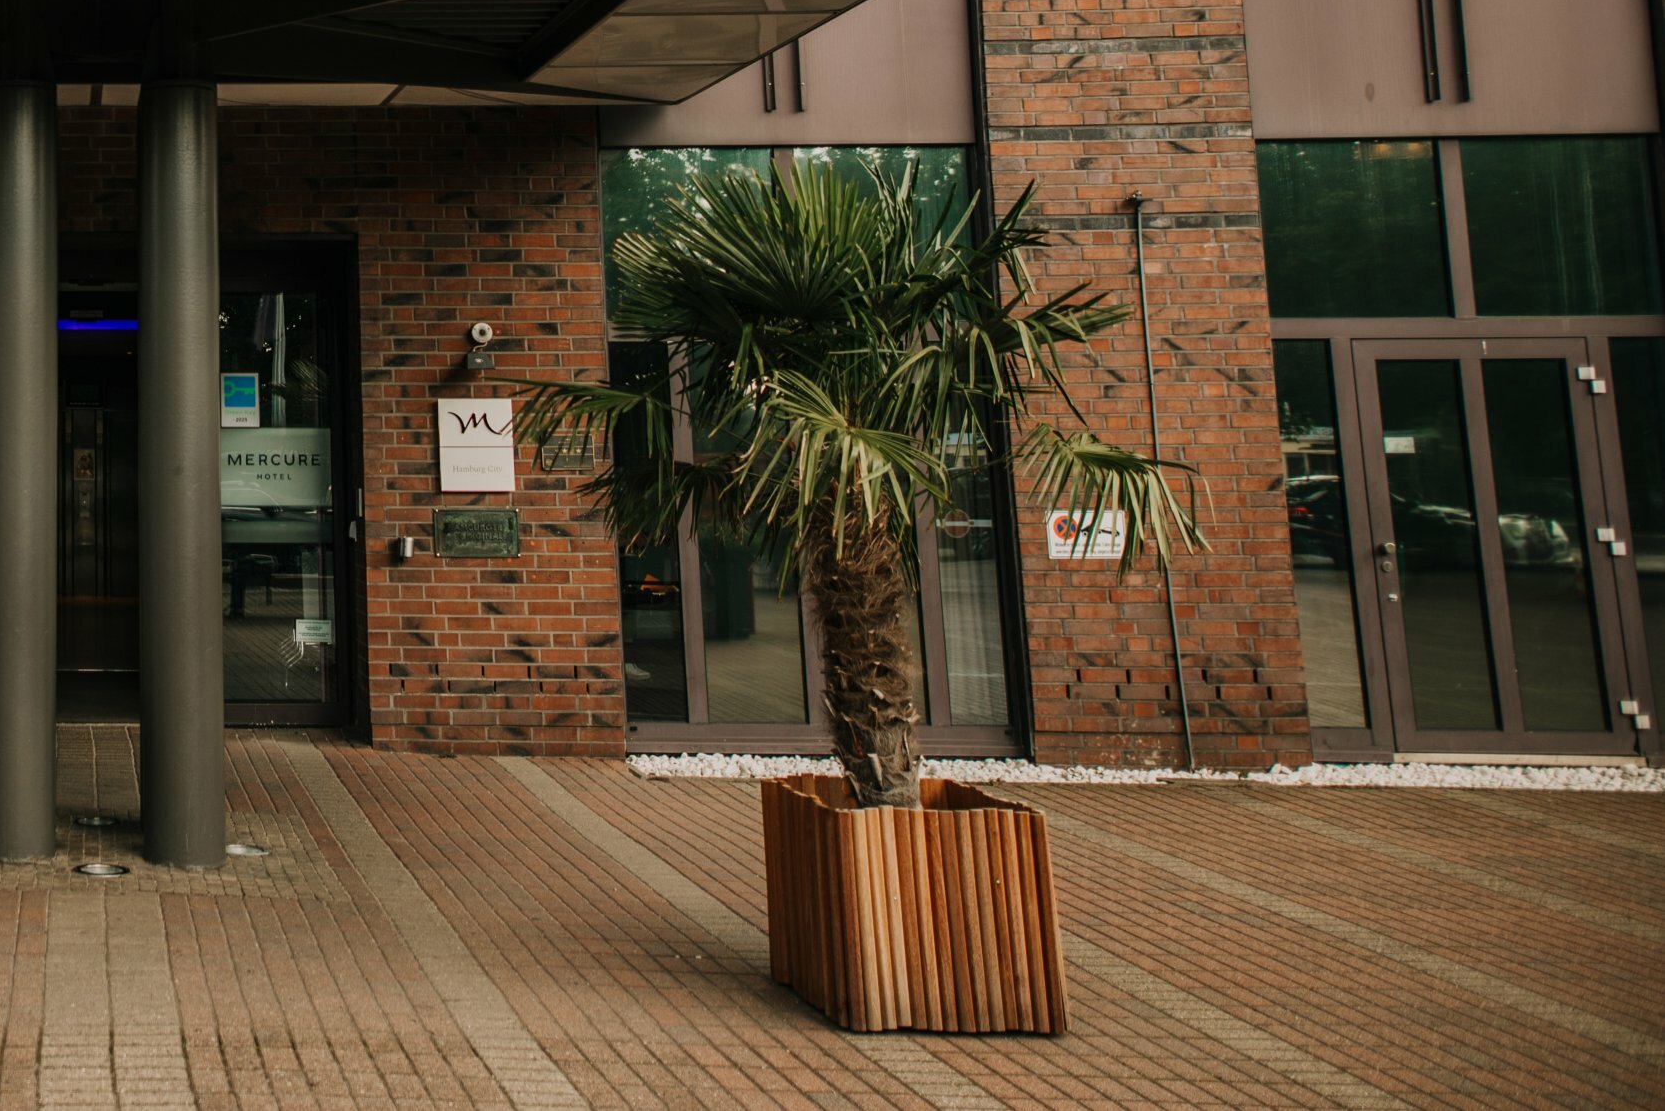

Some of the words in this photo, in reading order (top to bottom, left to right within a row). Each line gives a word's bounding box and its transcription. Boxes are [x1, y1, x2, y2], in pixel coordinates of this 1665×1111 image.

[227, 453, 322, 467] MERCURE
[452, 464, 486, 474] Hamburg
[487, 464, 503, 474] City
[256, 473, 292, 481] HOTEL
